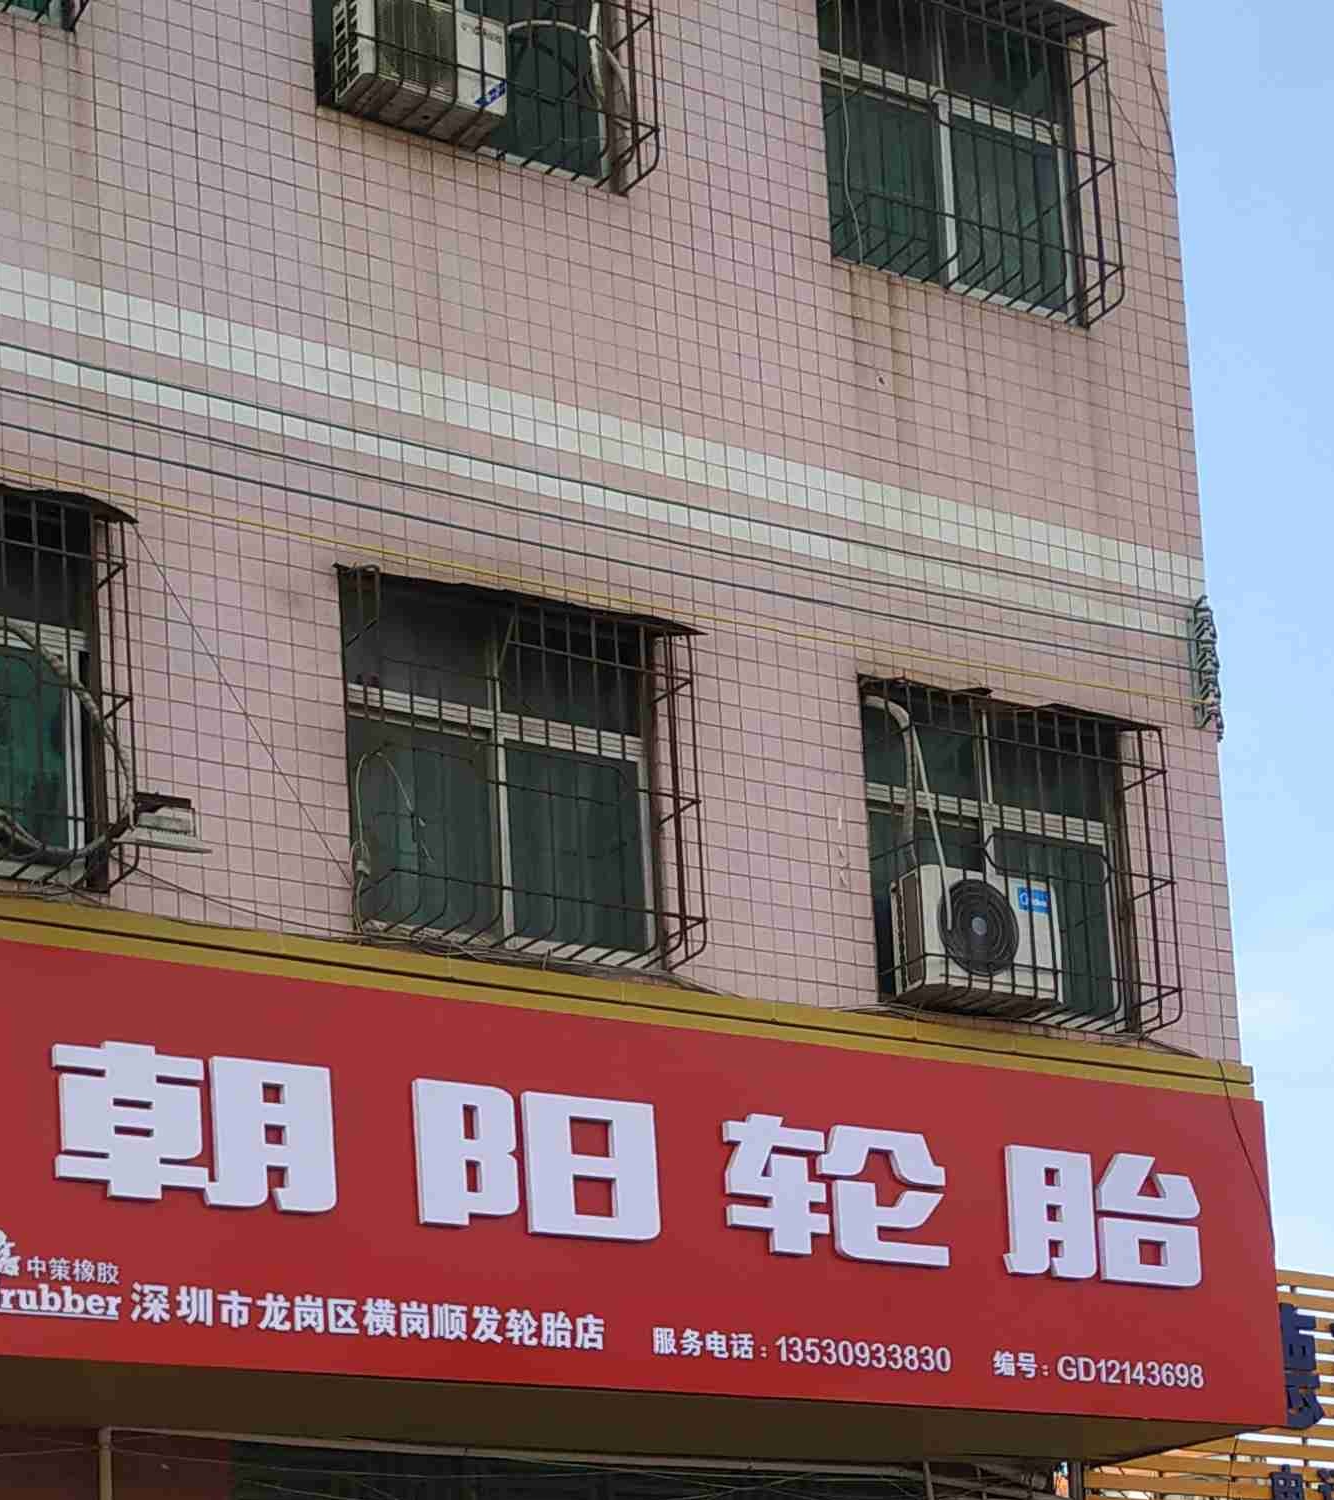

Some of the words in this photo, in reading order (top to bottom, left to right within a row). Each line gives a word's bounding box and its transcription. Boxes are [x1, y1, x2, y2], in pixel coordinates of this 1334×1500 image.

[51, 1040, 1202, 1289] 朝阳轮胎
[26, 1256, 120, 1285] 中策橡胶
[130, 1282, 605, 1350] 深圳市龙岗区横岗顺发轮胎店
